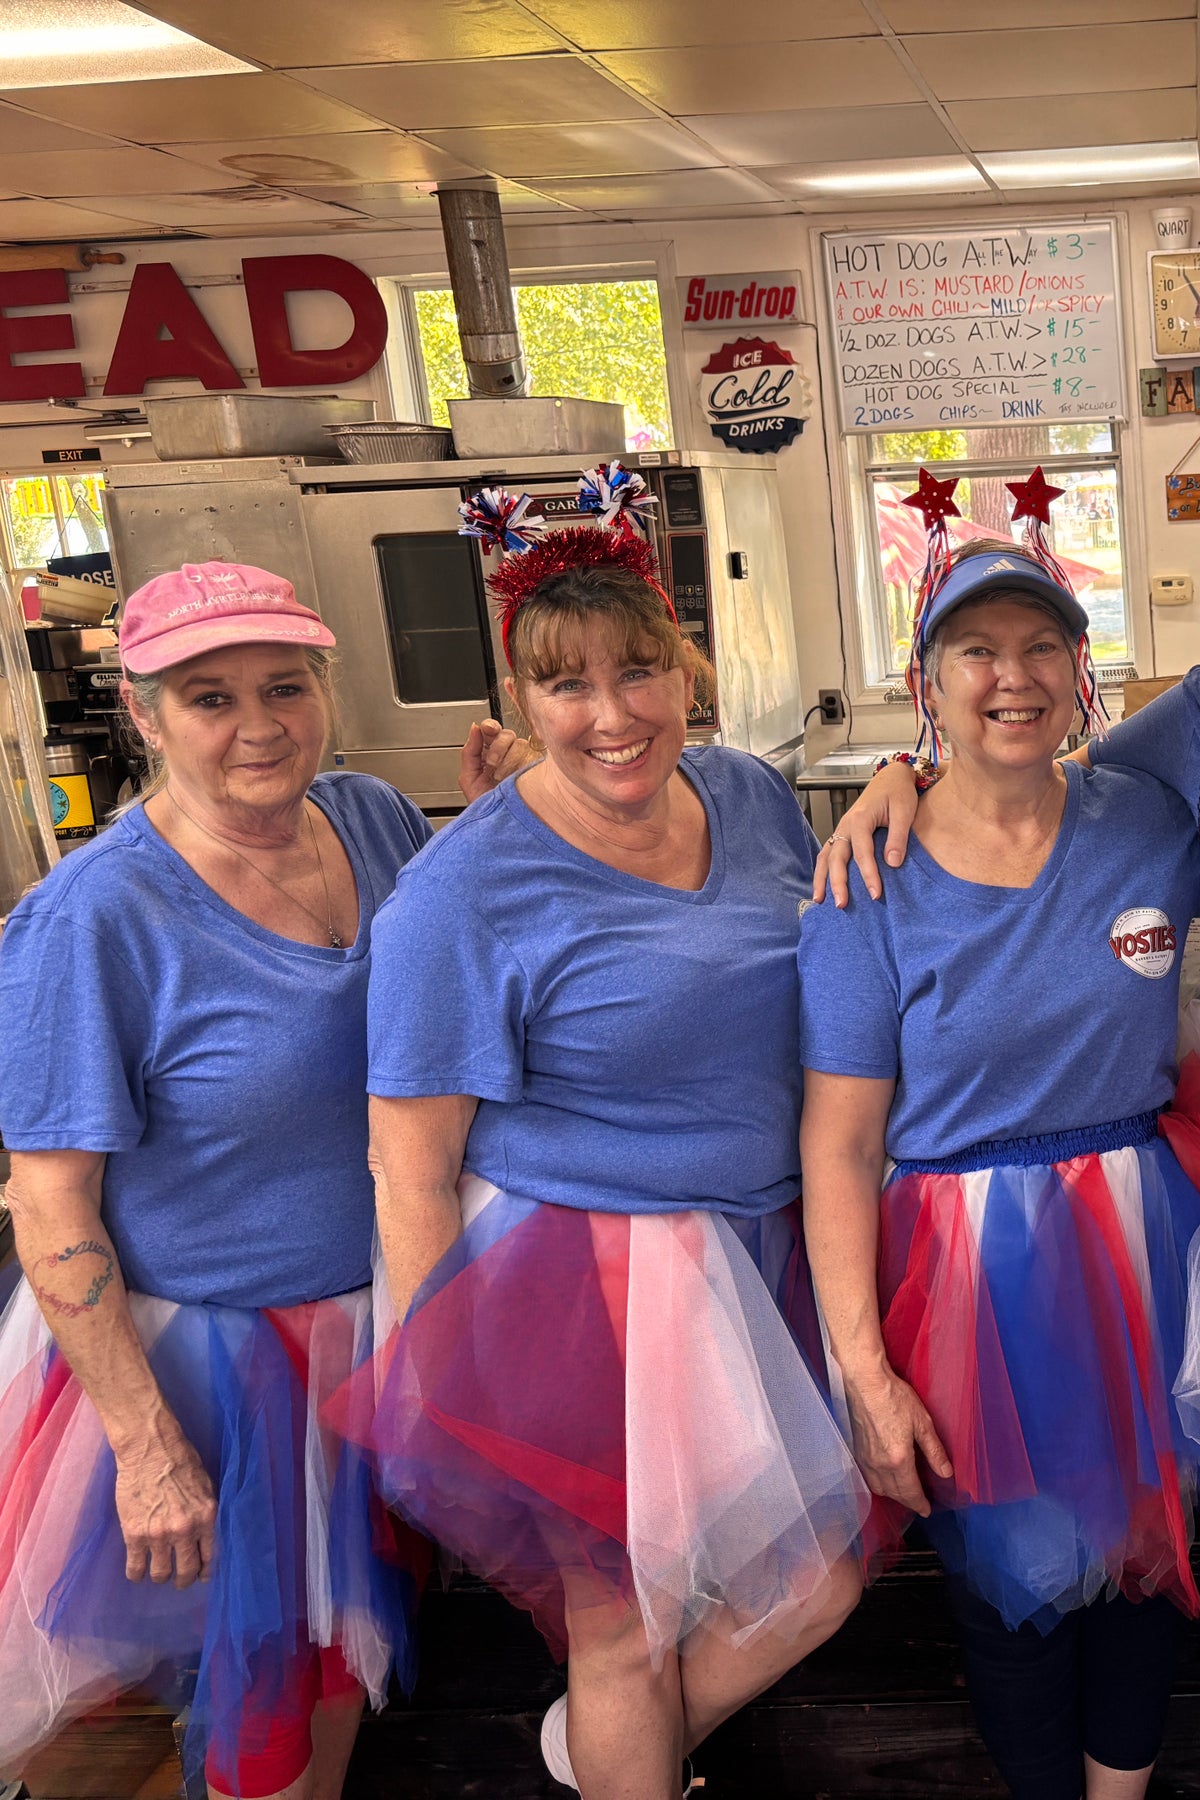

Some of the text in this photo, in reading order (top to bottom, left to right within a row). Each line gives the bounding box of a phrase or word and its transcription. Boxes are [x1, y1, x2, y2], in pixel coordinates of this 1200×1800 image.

[1157, 219, 1189, 237] QUART
[833, 243, 885, 274] HOT
[897, 241, 948, 270] DOG
[899, 278, 925, 298] IS:
[934, 274, 1014, 297] MUSTARD
[1163, 279, 1174, 292] 10
[684, 277, 797, 323] Sun-drop
[852, 303, 884, 322] OUR
[888, 302, 924, 318] OWN
[1057, 295, 1105, 314] SPICY
[1160, 299, 1168, 311] 9
[1167, 317, 1175, 330] 8
[866, 333, 900, 350] DOZ.
[906, 325, 955, 348] DOGS
[1181, 330, 1188, 343] 7
[733, 350, 763, 369] ICE
[842, 363, 903, 384] DOZEN
[909, 358, 961, 379] DOGS
[708, 369, 794, 409] Cold
[865, 380, 1020, 404] HOT DOG SPECIAL
[855, 406, 869, 425] 2
[870, 406, 914, 425] DOGS
[939, 405, 978, 421] CHIPS
[1002, 399, 1046, 418] DRINK
[728, 418, 786, 437] DRINKS
[58, 450, 84, 461] EXIT
[167, 600, 202, 619] NORTH
[1109, 925, 1177, 959] YOSTIES
